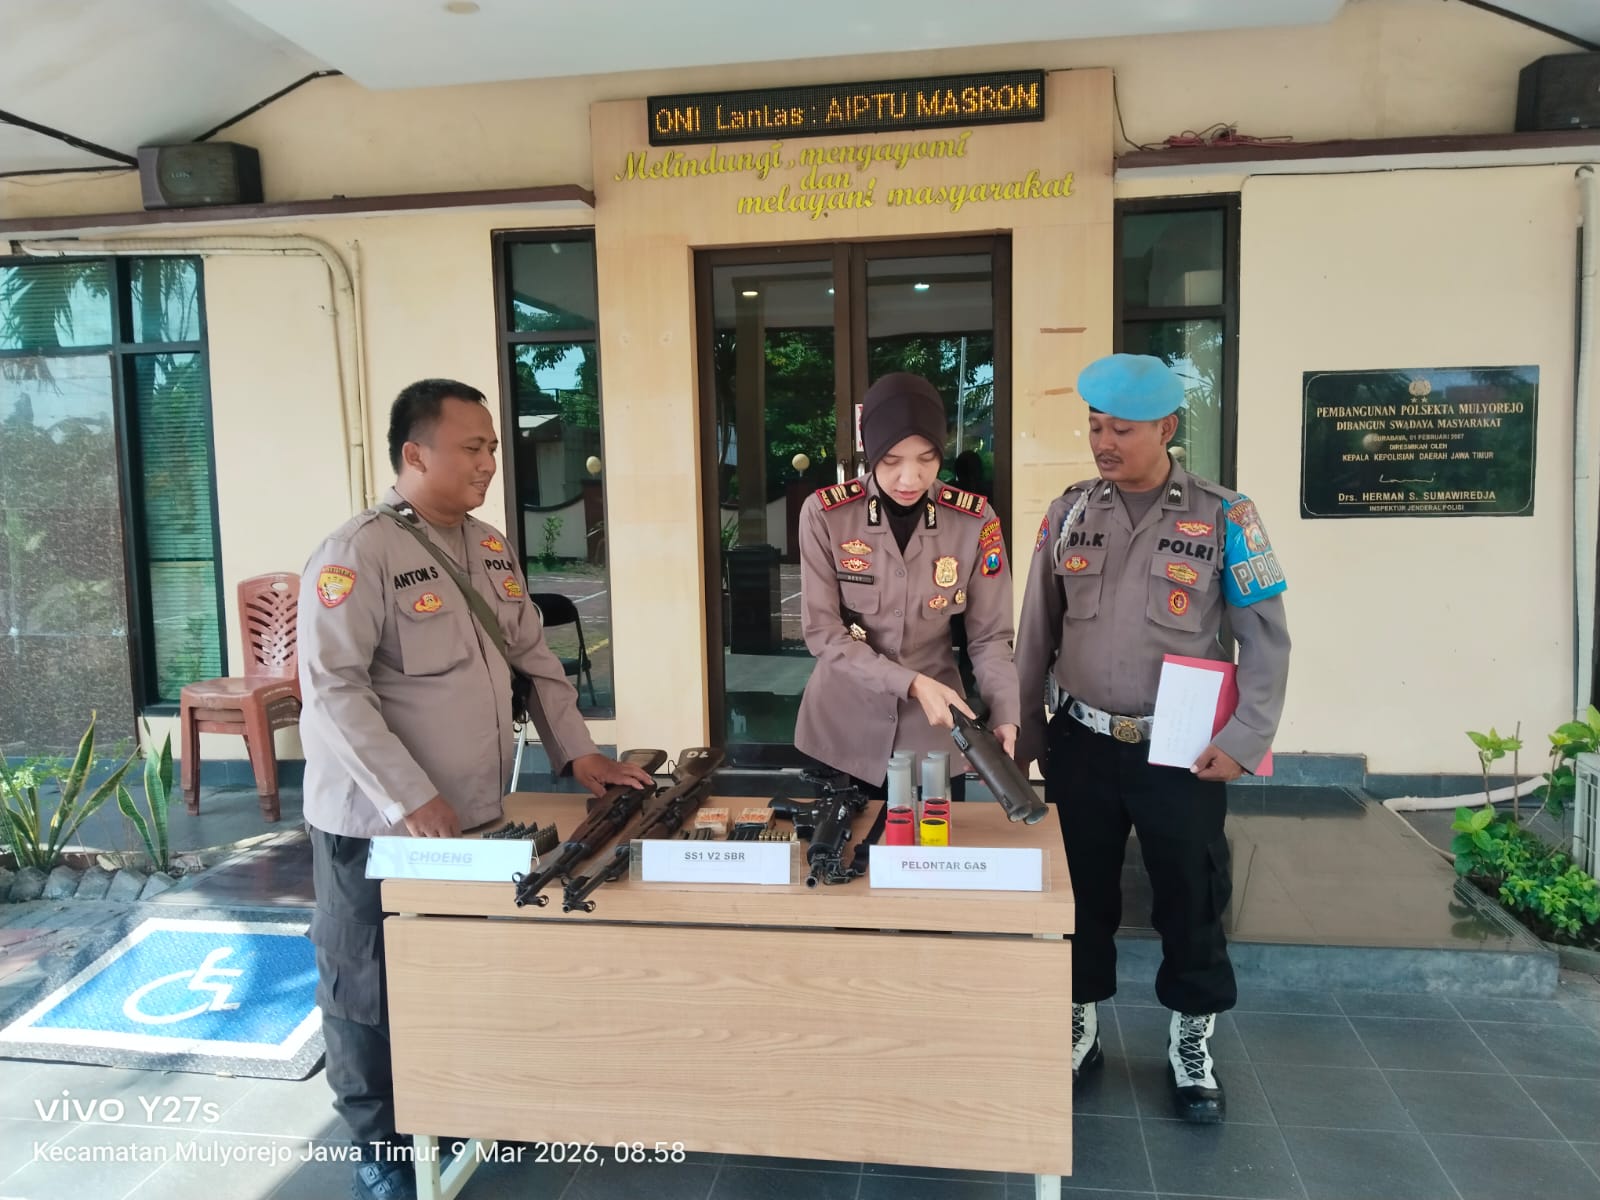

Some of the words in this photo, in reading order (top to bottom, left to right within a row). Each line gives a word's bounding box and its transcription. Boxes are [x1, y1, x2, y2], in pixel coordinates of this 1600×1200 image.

[655, 105, 701, 134] ONI
[825, 91, 908, 124] AIPTU
[800, 130, 974, 172] mengayomi
[800, 165, 852, 192] dan
[887, 168, 1076, 214] masyarakat
[1316, 405, 1396, 418] PEMBANGUNAN
[1401, 404, 1455, 416] POLSEKTA
[1459, 402, 1524, 415] MULYOREJO
[1336, 420, 1386, 431] DIBANGUN
[1389, 419, 1434, 430] SWADAYA
[1437, 417, 1502, 429] MASYARAKAT
[1342, 453, 1370, 462] KEPALA
[1374, 452, 1415, 461] KEPOLISIAN
[1419, 452, 1448, 460] DAERAH
[1450, 451, 1470, 460] JAWA
[1472, 451, 1495, 459] TIMUR
[1338, 493, 1357, 502] Drs.
[1362, 491, 1405, 501] HERMAN
[1408, 491, 1418, 501] S.
[1423, 491, 1496, 501] SUMAWIREDJA
[1407, 504, 1441, 512] JENDERAL
[1157, 537, 1214, 562] POLRI
[393, 568, 431, 590] ANTON
[431, 566, 439, 579] S
[409, 850, 473, 864] CHOENG
[684, 851, 704, 862] SS1
[707, 851, 721, 862] V2
[724, 851, 746, 862] SBR
[901, 860, 960, 871] PELONTAR
[963, 862, 988, 872] GAS
